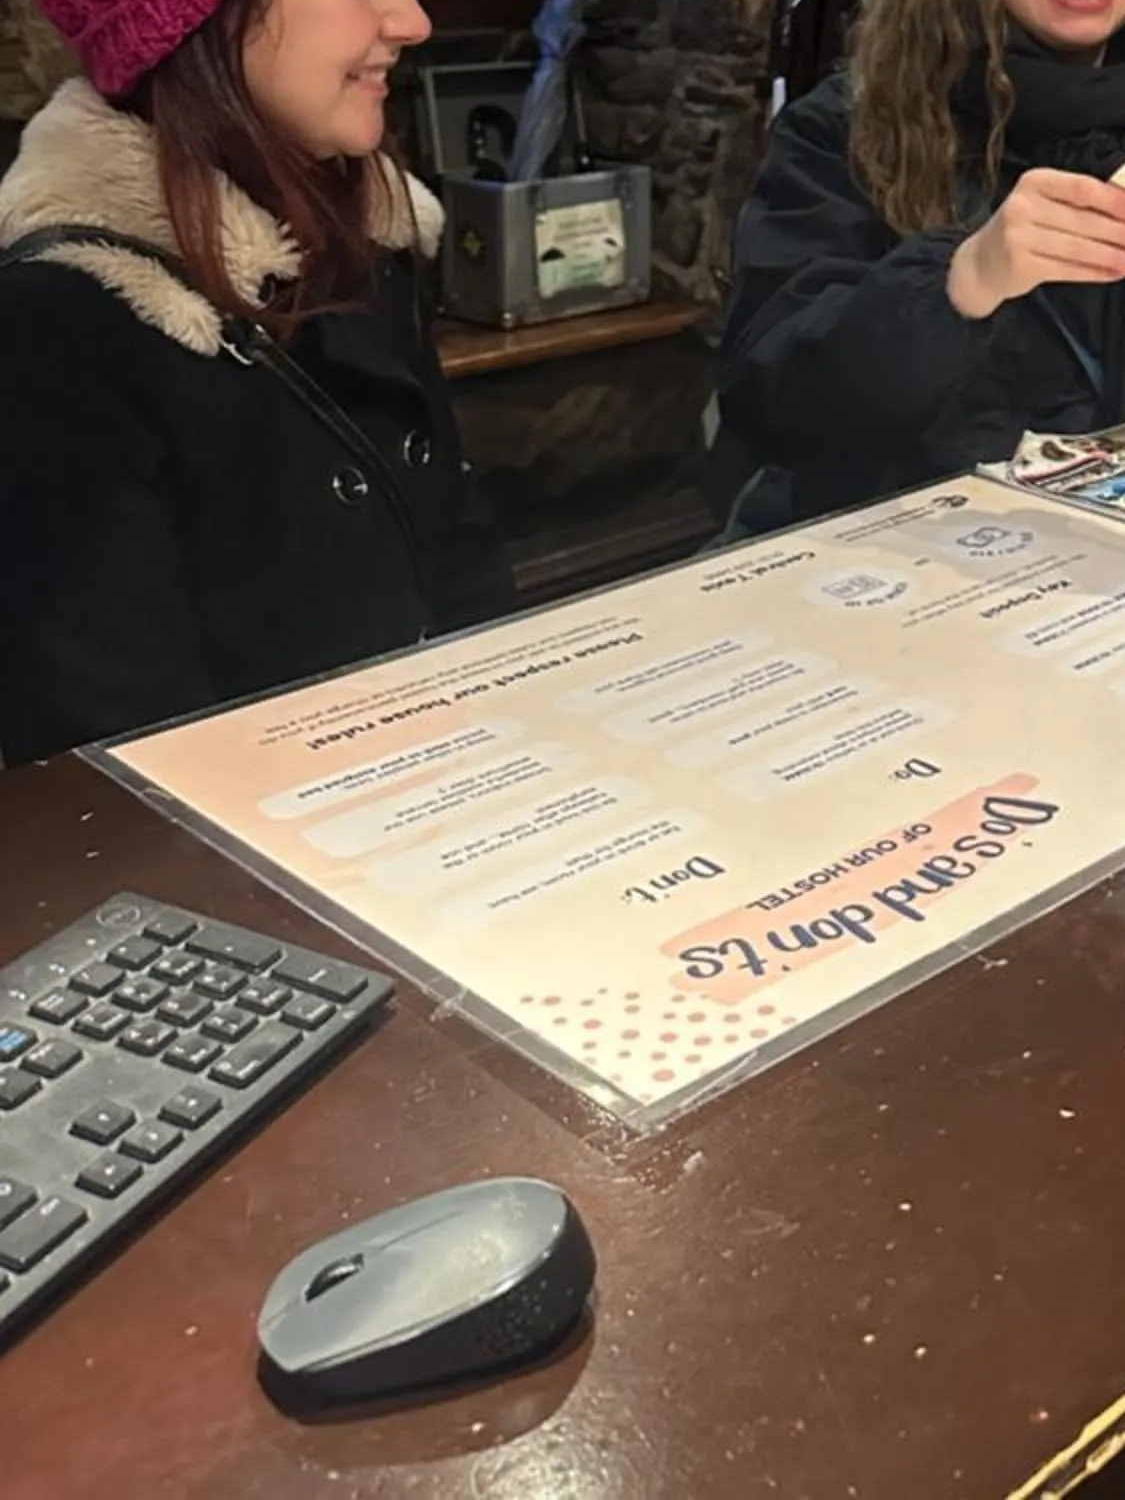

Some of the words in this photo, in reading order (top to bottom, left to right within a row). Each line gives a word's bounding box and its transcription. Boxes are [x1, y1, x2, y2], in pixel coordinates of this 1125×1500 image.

[573, 632, 643, 658] Please
[492, 655, 571, 686] respect
[453, 683, 490, 700] our
[378, 697, 451, 724] house
[902, 823, 932, 843] OF
[951, 794, 1060, 859] Do's
[843, 839, 898, 867] OUR
[745, 863, 849, 911] HOSTEL
[870, 853, 977, 923] and
[677, 902, 877, 980] don'ts
